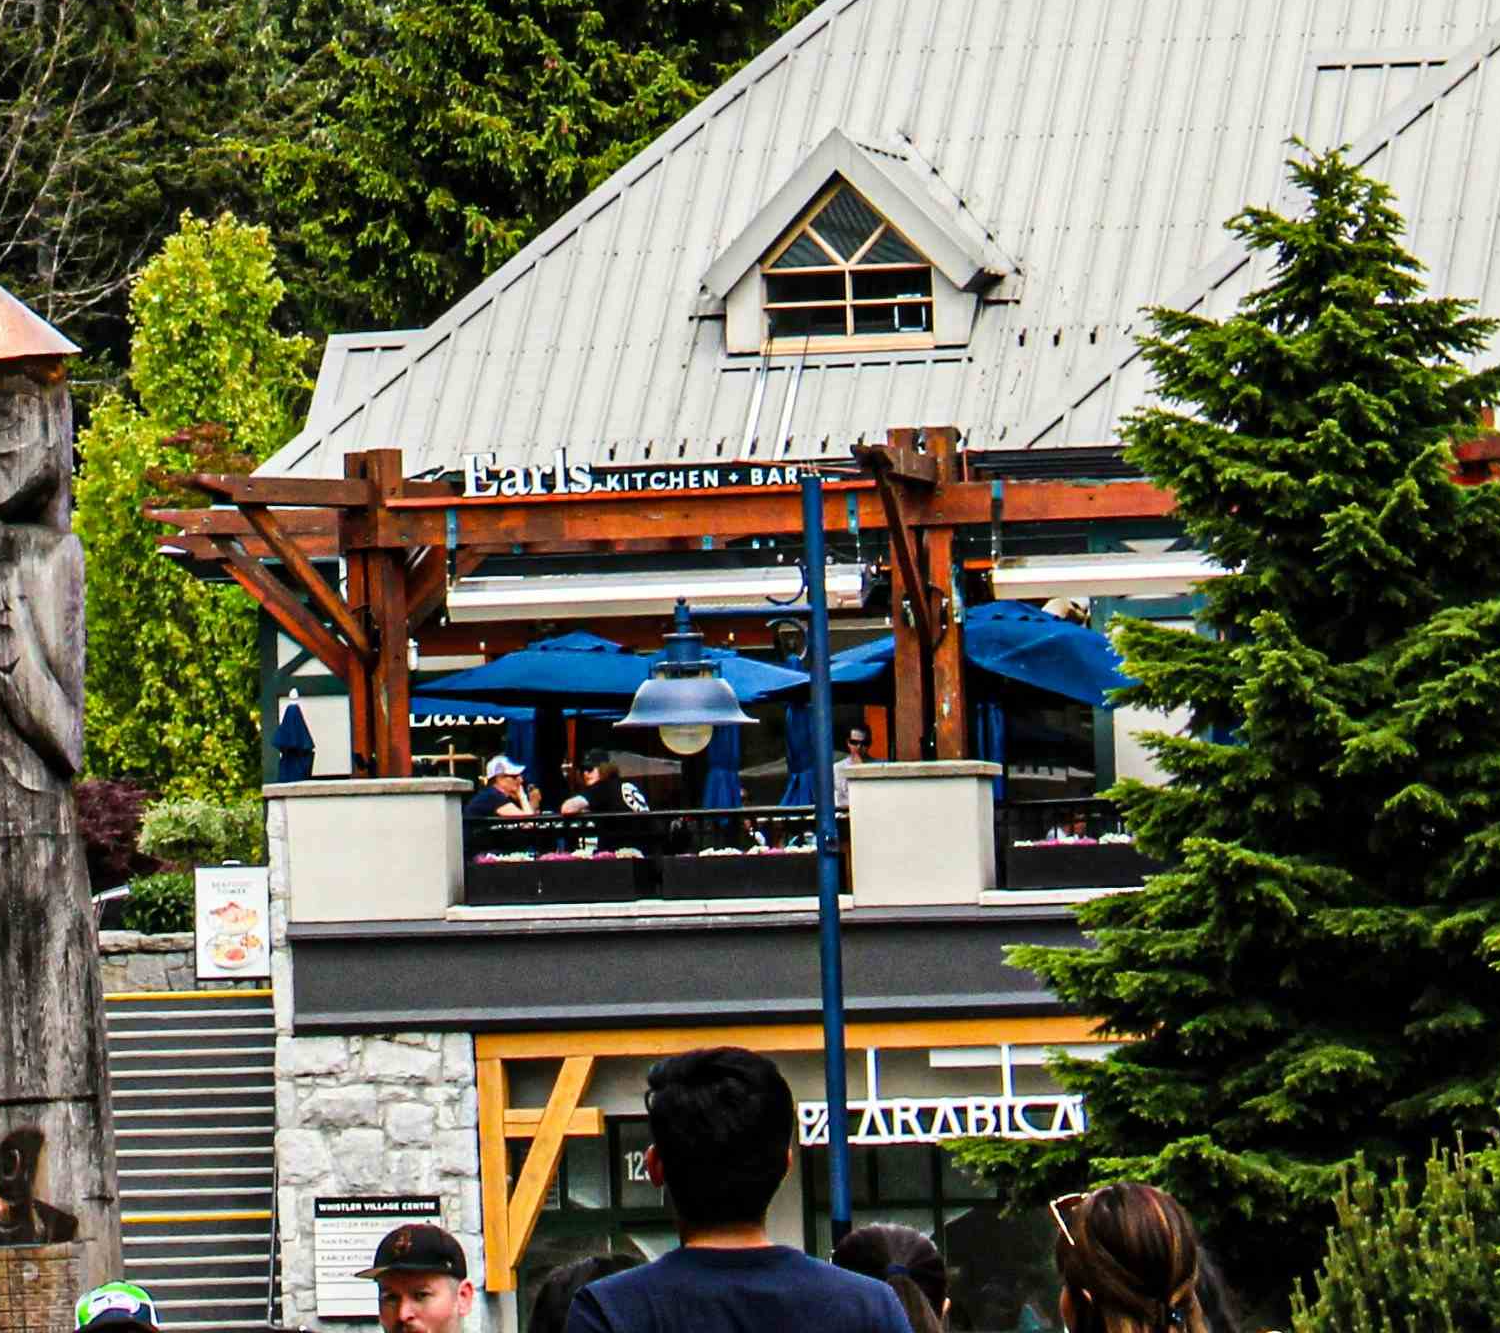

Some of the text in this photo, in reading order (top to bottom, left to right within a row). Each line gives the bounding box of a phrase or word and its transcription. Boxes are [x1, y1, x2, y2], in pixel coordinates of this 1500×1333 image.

[462, 447, 594, 498] Earls
[606, 469, 720, 492] KITCHEN
[750, 466, 798, 486] BAR
[857, 1096, 1086, 1140] ARABICA
[318, 1201, 435, 1211] WHISTLER VILLAGE CENTRE
